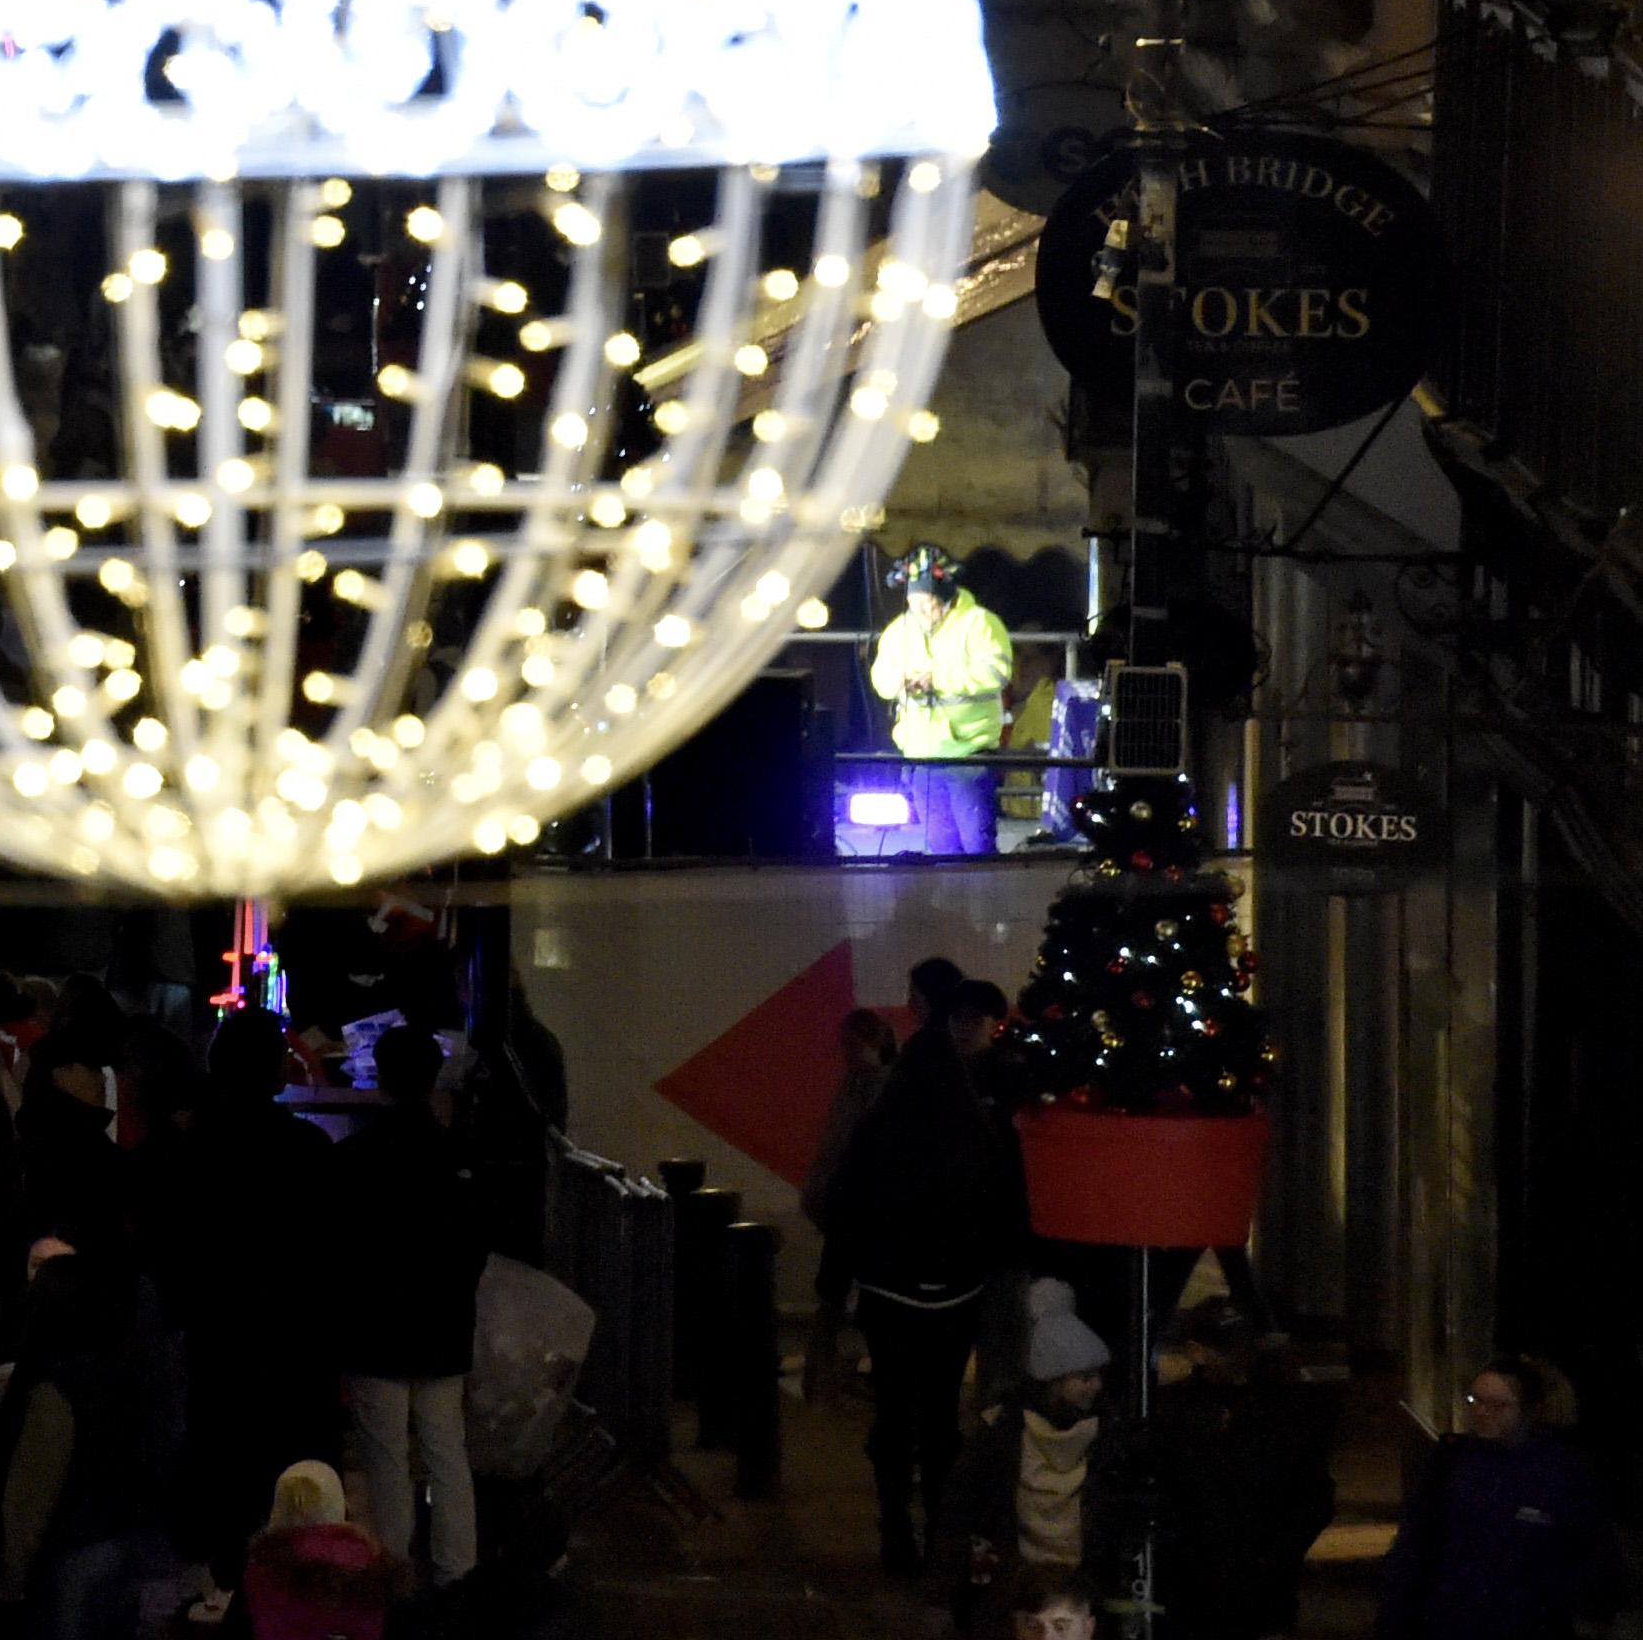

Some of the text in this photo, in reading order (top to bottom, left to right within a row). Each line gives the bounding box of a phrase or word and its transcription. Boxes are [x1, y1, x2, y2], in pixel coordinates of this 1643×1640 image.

[1227, 155, 1402, 237] BRIDGE
[1184, 372, 1301, 412] CAFÉ
[1290, 810, 1418, 842] STOKES
